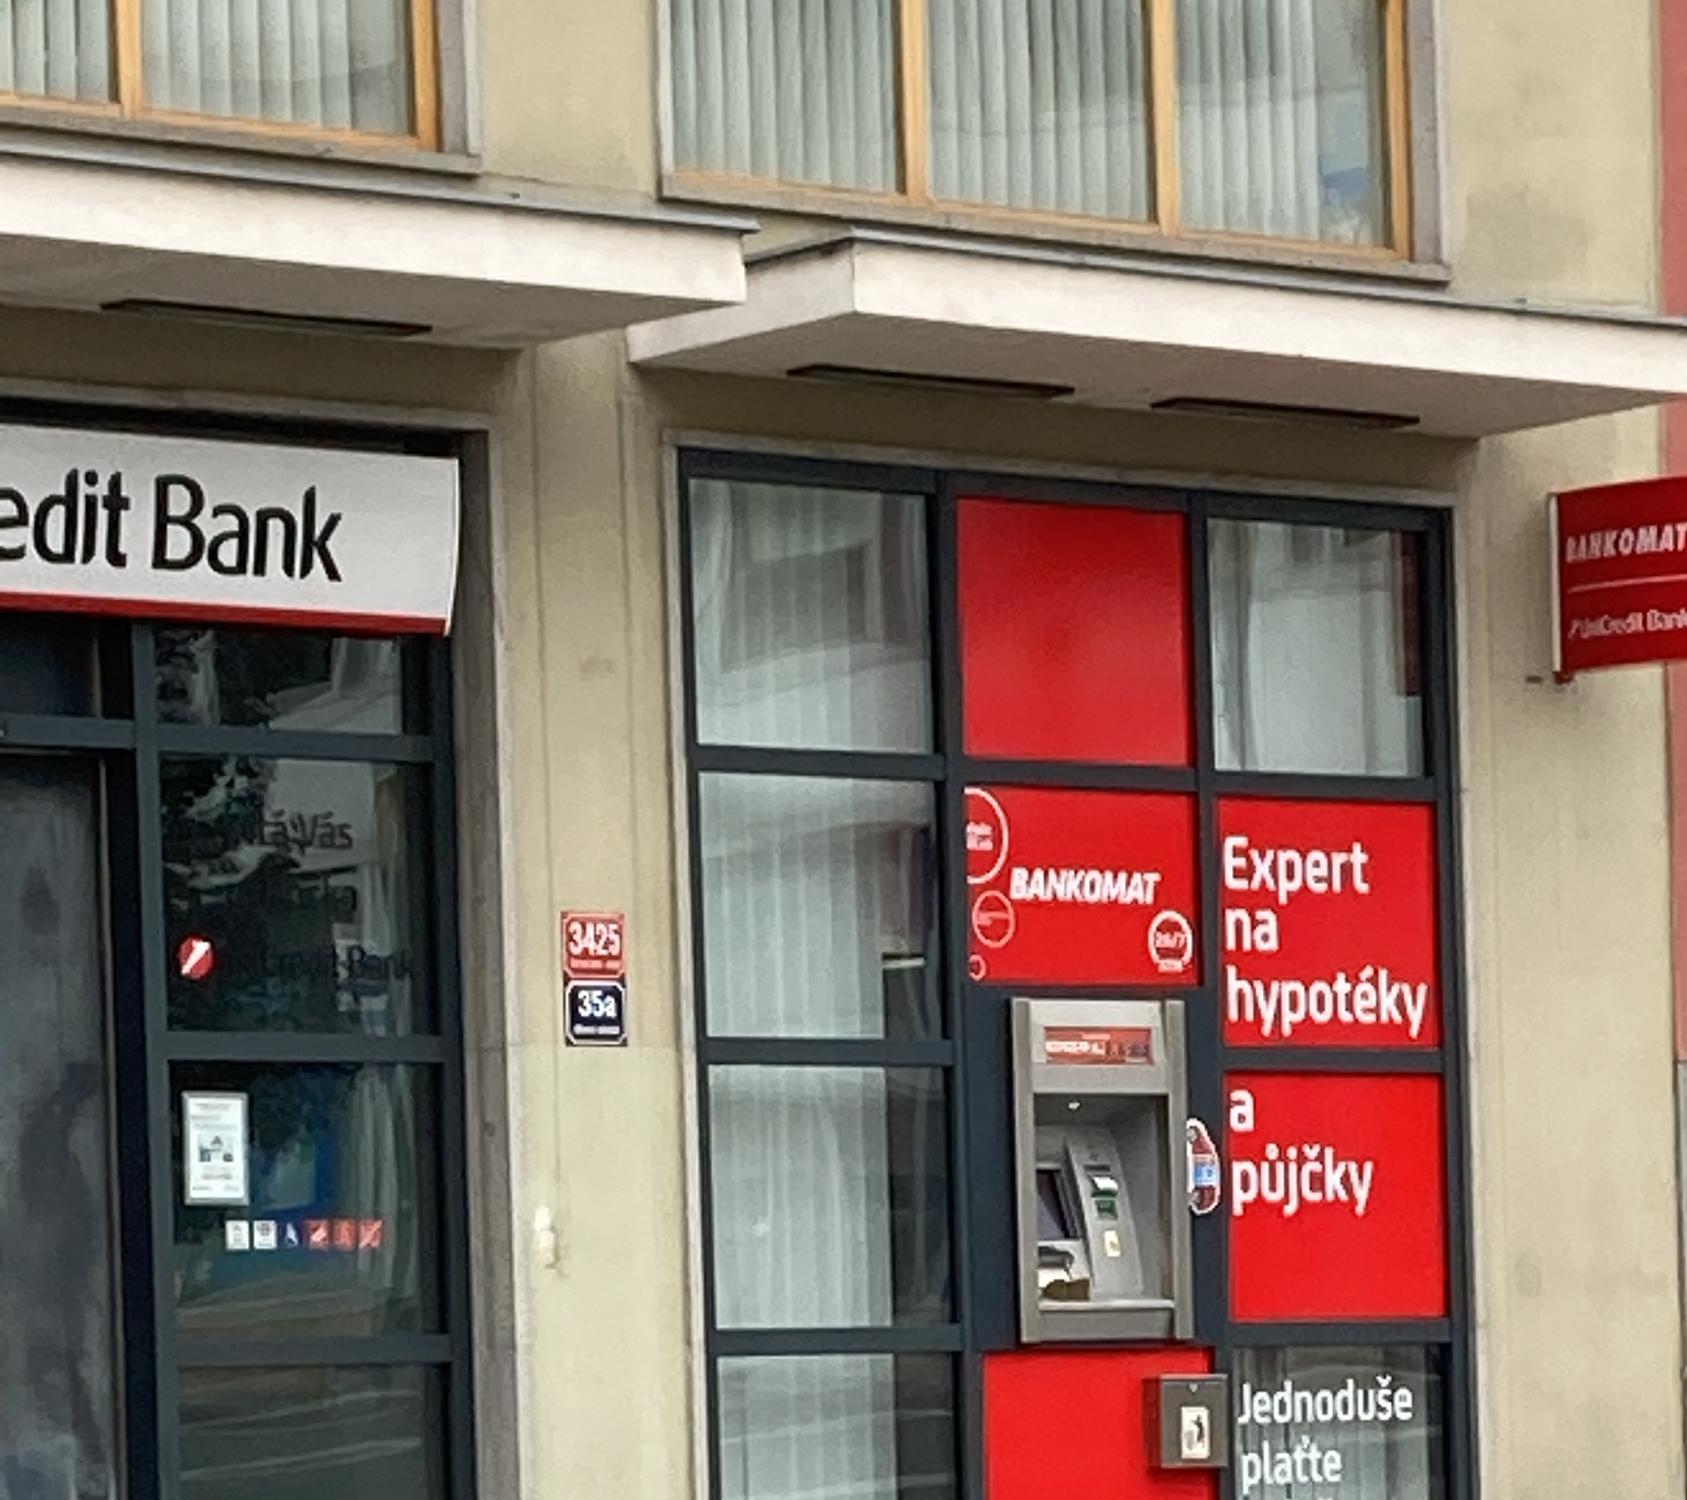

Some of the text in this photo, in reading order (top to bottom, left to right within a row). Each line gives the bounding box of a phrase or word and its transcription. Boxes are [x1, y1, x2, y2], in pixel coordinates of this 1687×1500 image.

[152, 475, 342, 582] Bank
[1565, 522, 1687, 564] BANKOMAT
[1010, 867, 1162, 904] BANKOMAT
[1223, 835, 1370, 905] Expert
[568, 921, 620, 956] 3425
[1224, 907, 1279, 952] na
[578, 990, 617, 1018] 35a
[1227, 965, 1428, 1039] hypotéky
[1229, 1089, 1254, 1132] a
[1232, 1143, 1373, 1217] půjčky
[1238, 1375, 1413, 1424] Jednoduše
[1242, 1435, 1342, 1495] plaťte
